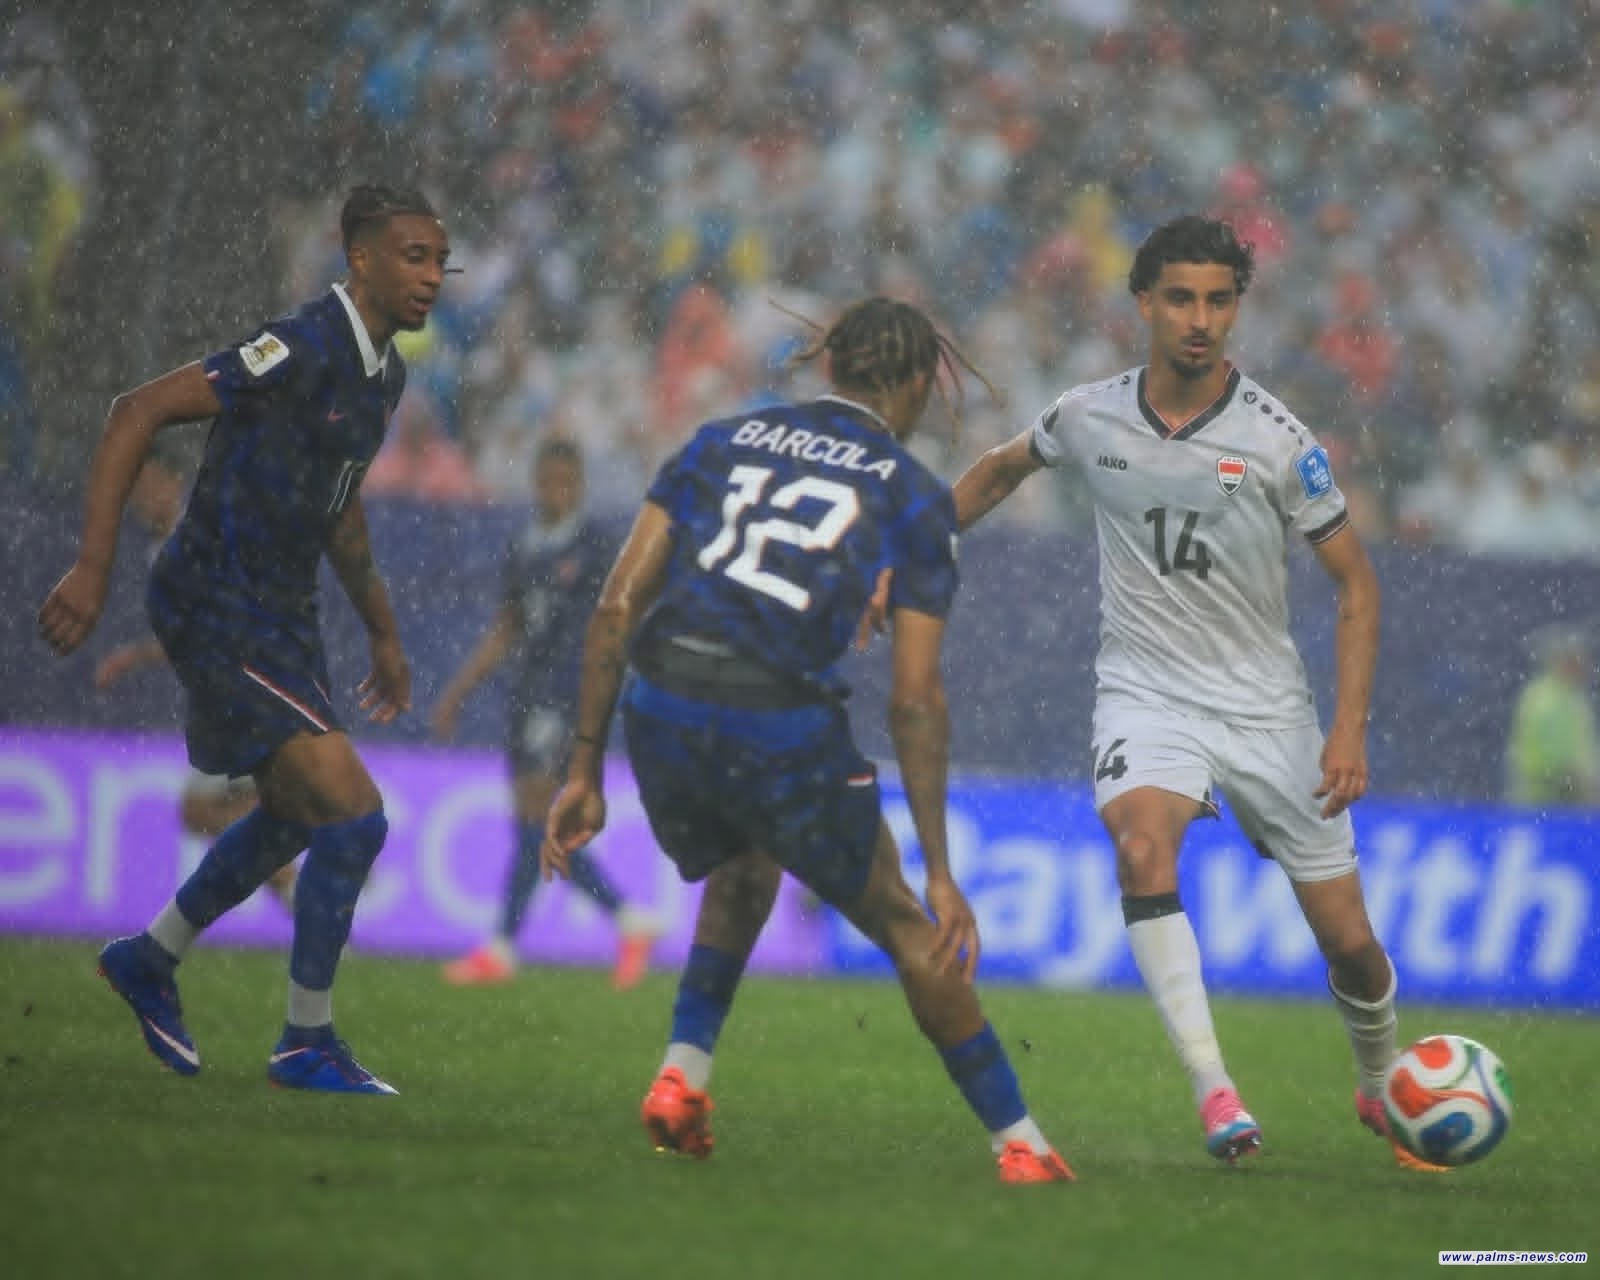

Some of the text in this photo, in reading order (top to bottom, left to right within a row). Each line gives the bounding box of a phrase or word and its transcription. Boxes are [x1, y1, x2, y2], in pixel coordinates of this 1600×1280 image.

[731, 420, 897, 480] BARCOLA
[1096, 454, 1128, 471] JAKO
[697, 464, 861, 612] 12
[1144, 507, 1212, 579] 14
[1200, 820, 1590, 984] with
